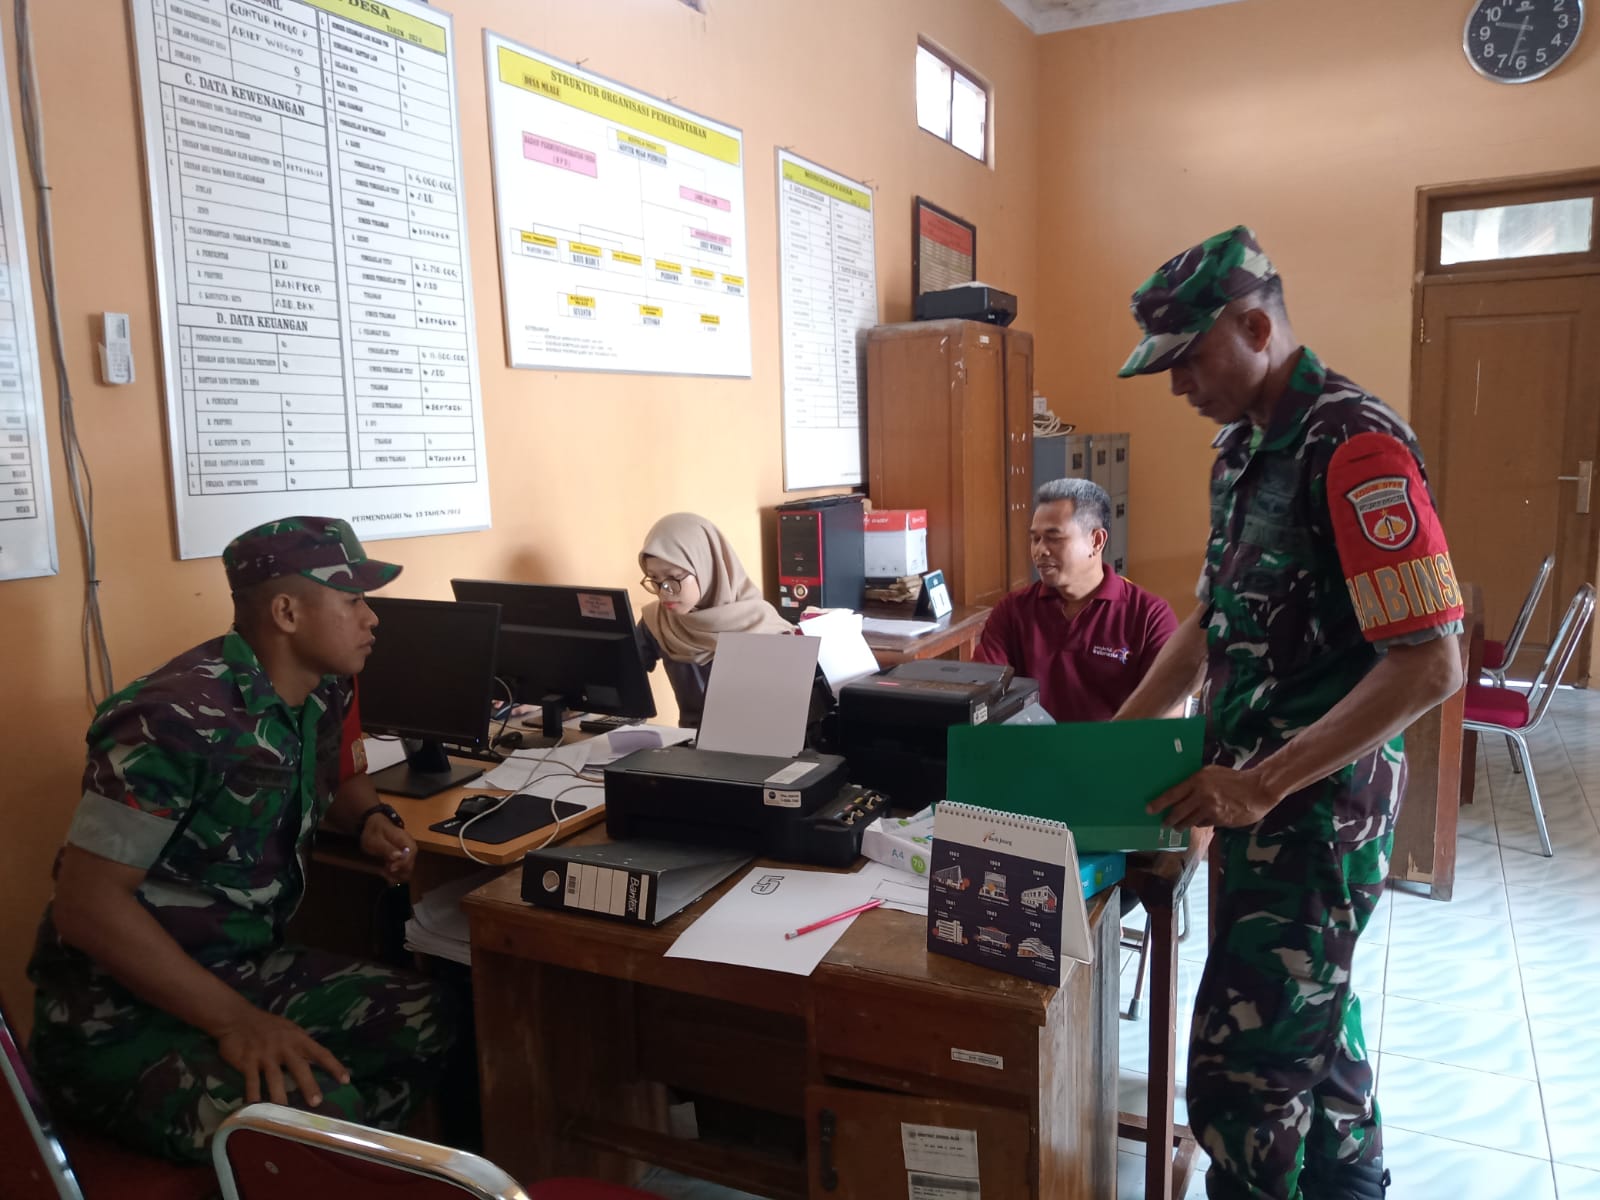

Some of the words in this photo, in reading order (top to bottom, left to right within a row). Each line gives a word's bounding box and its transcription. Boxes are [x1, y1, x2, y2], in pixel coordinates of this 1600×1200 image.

[1485, 6, 1501, 22] 10
[1557, 14, 1568, 29] 3
[1479, 26, 1491, 41] 9
[1551, 33, 1561, 46] 4
[1483, 43, 1494, 58] 8
[1535, 48, 1546, 62] 5
[1497, 53, 1508, 68] 7
[1515, 55, 1527, 70] 6
[200, 76, 228, 97] DATA
[231, 86, 305, 117] KEWENANGAN
[551, 70, 600, 99] STRUKTUR
[601, 89, 650, 117] ORGANISASI
[230, 313, 255, 328] DATA
[257, 317, 308, 332] KEUANGAN
[1346, 553, 1464, 631] ABINS
[891, 847, 905, 861] A4
[750, 874, 785, 896] 5
[627, 876, 640, 913] Bantex
